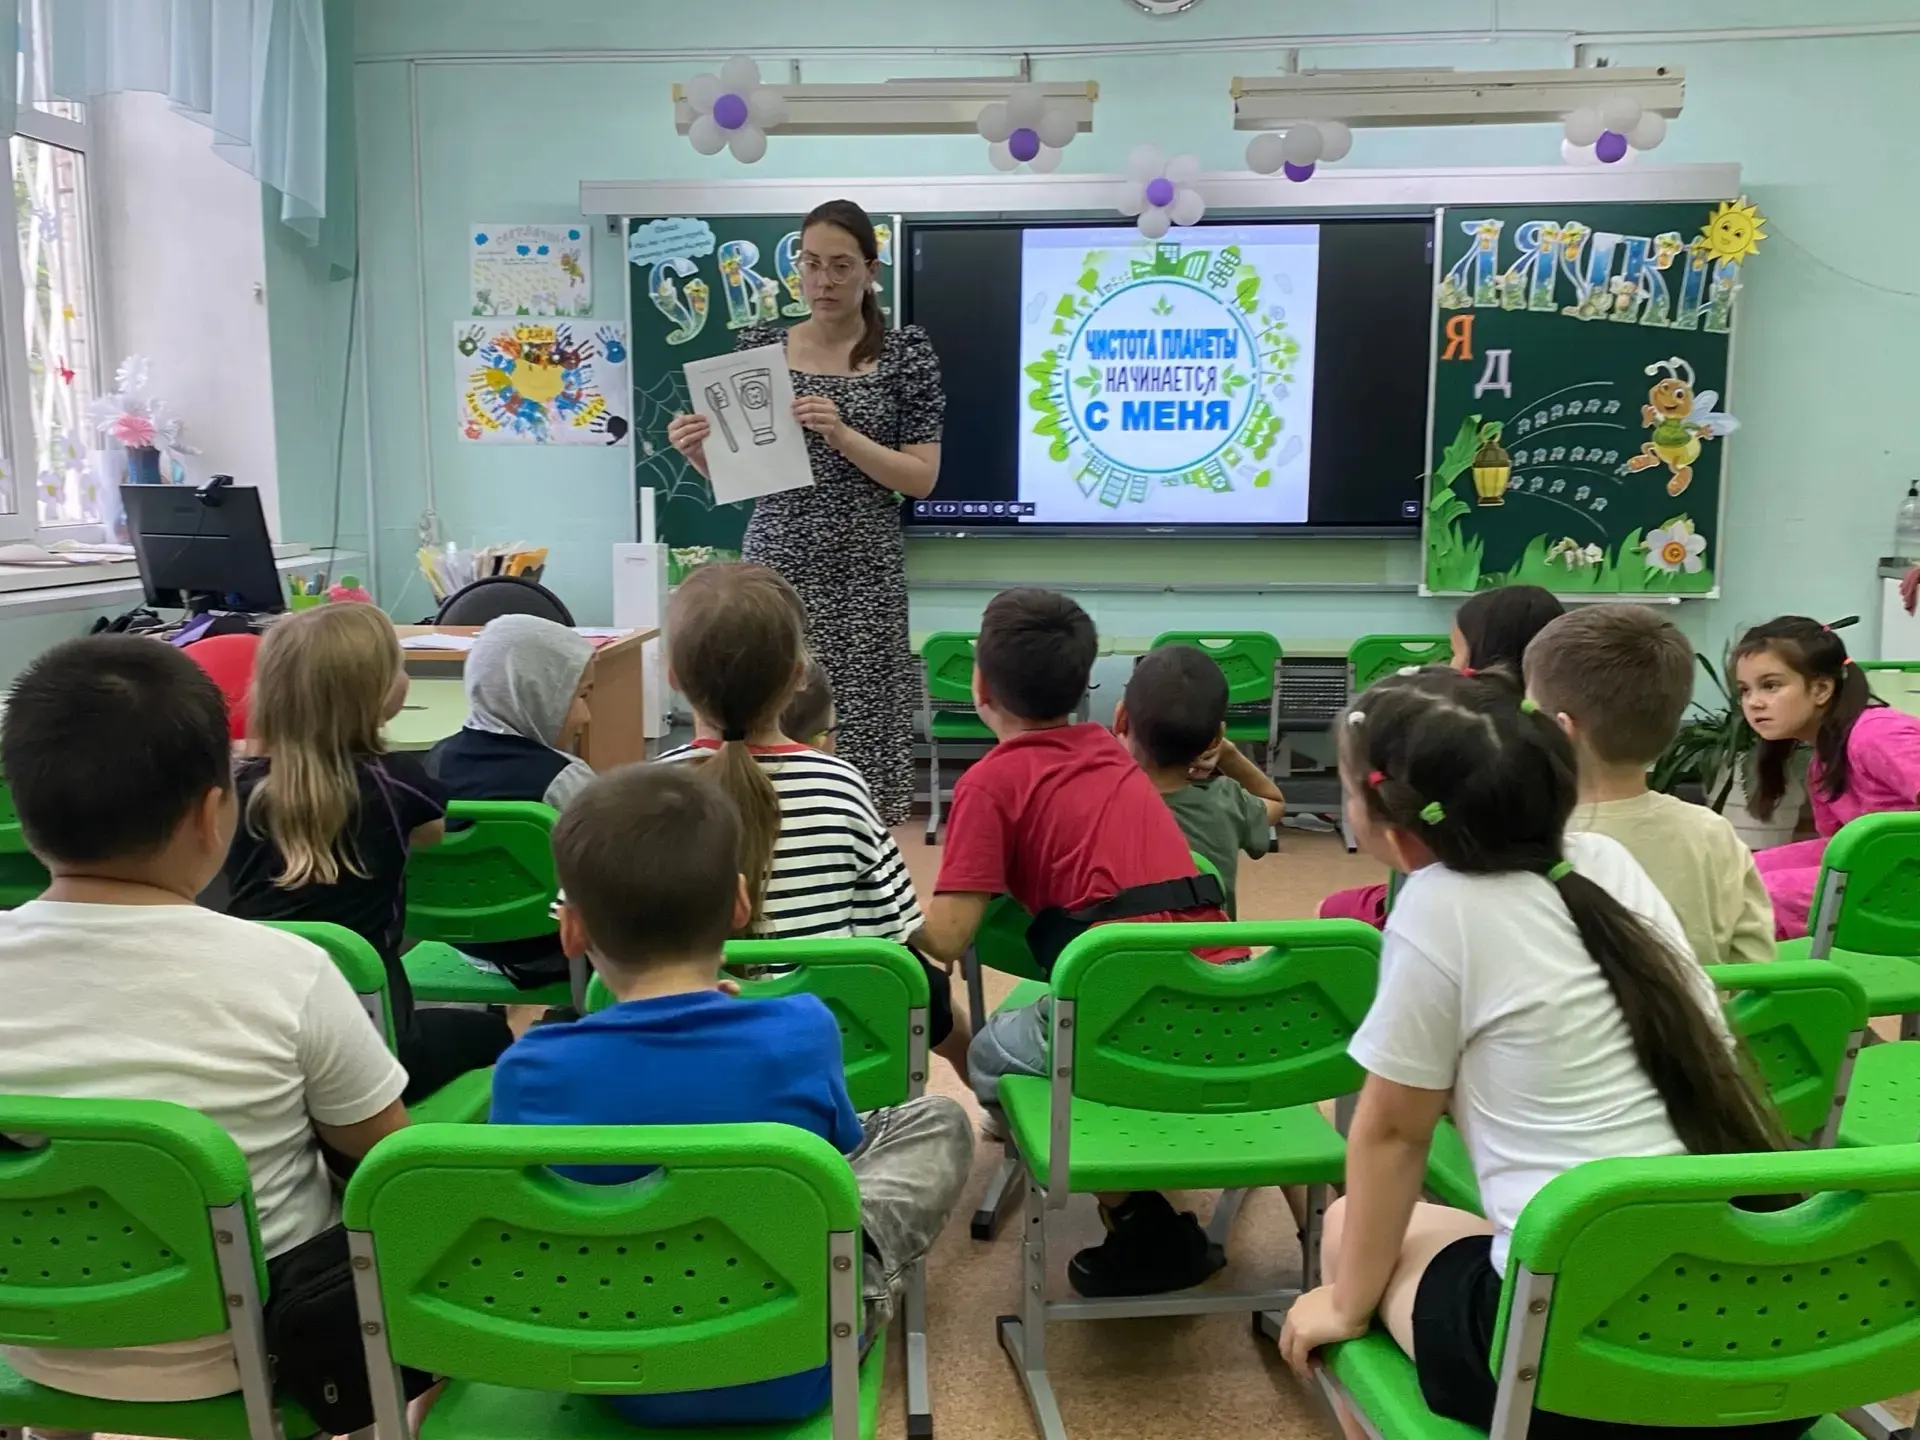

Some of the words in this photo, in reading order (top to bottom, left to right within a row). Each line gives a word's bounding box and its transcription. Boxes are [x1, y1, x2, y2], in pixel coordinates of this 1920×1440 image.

[1085, 328, 1158, 360] ЧИСТОТА
[1161, 328, 1239, 360] ПЛАНЕТЫ
[1440, 314, 1475, 360] Я
[1105, 366, 1218, 396] НАЧИНАЕТСЯ
[1474, 349, 1512, 399] Д
[1085, 401, 1109, 431] С
[1121, 400, 1230, 431] МЕНЯ
